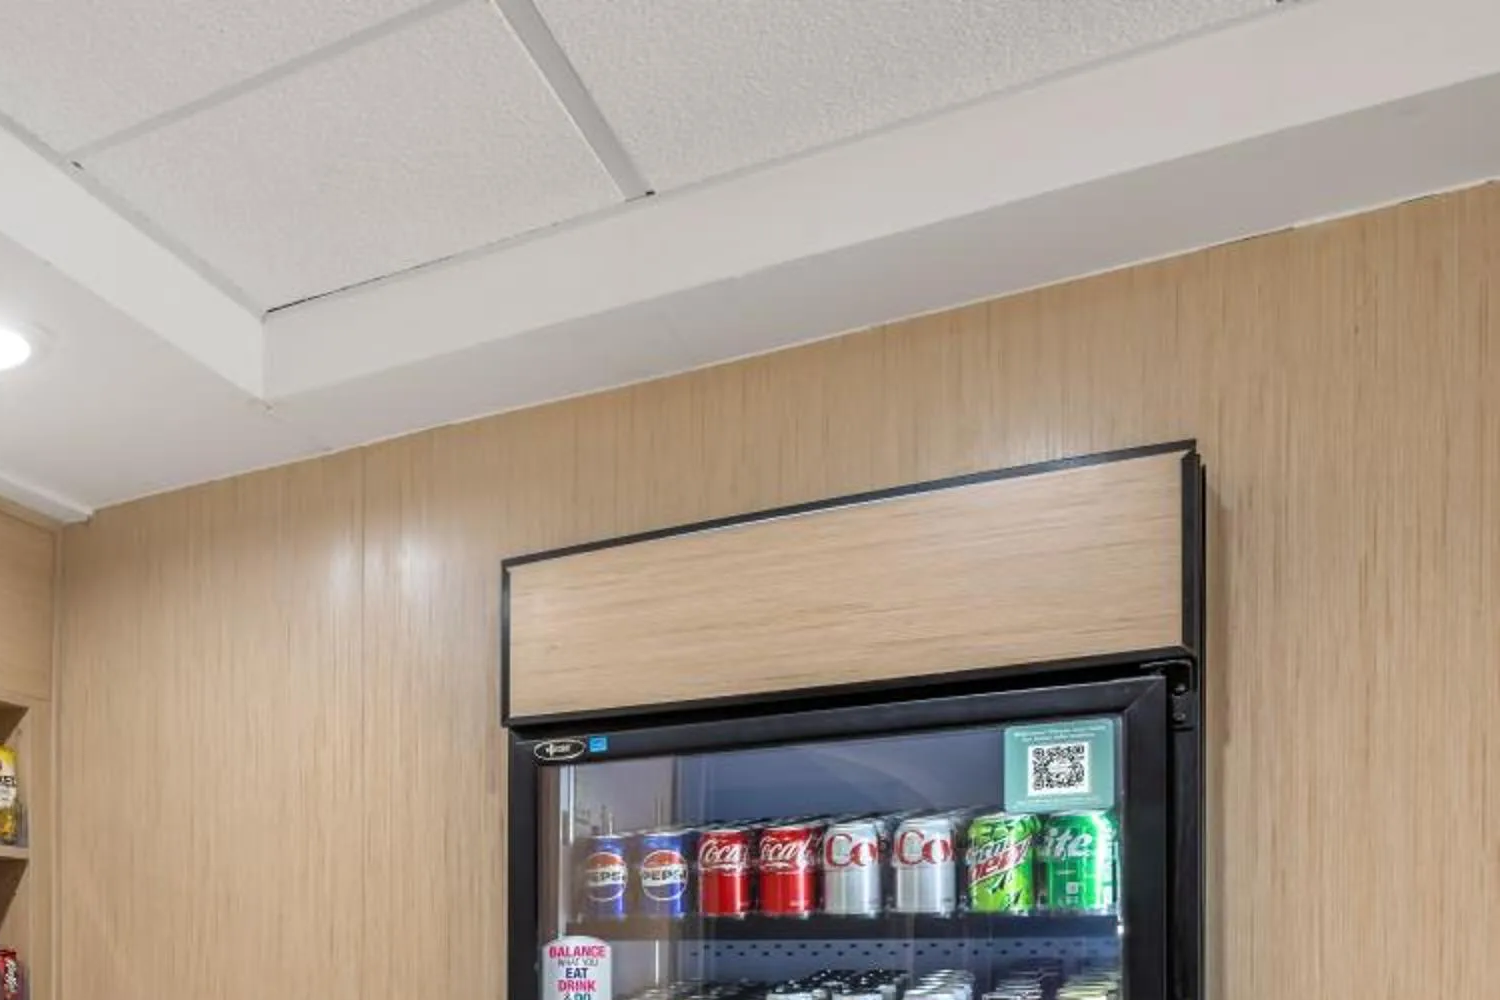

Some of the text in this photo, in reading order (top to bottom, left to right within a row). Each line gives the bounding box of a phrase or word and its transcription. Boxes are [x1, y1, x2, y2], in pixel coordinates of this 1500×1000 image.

[549, 945, 605, 957] BALANCE
[565, 967, 588, 979] EAT
[557, 980, 596, 992] DRINK
